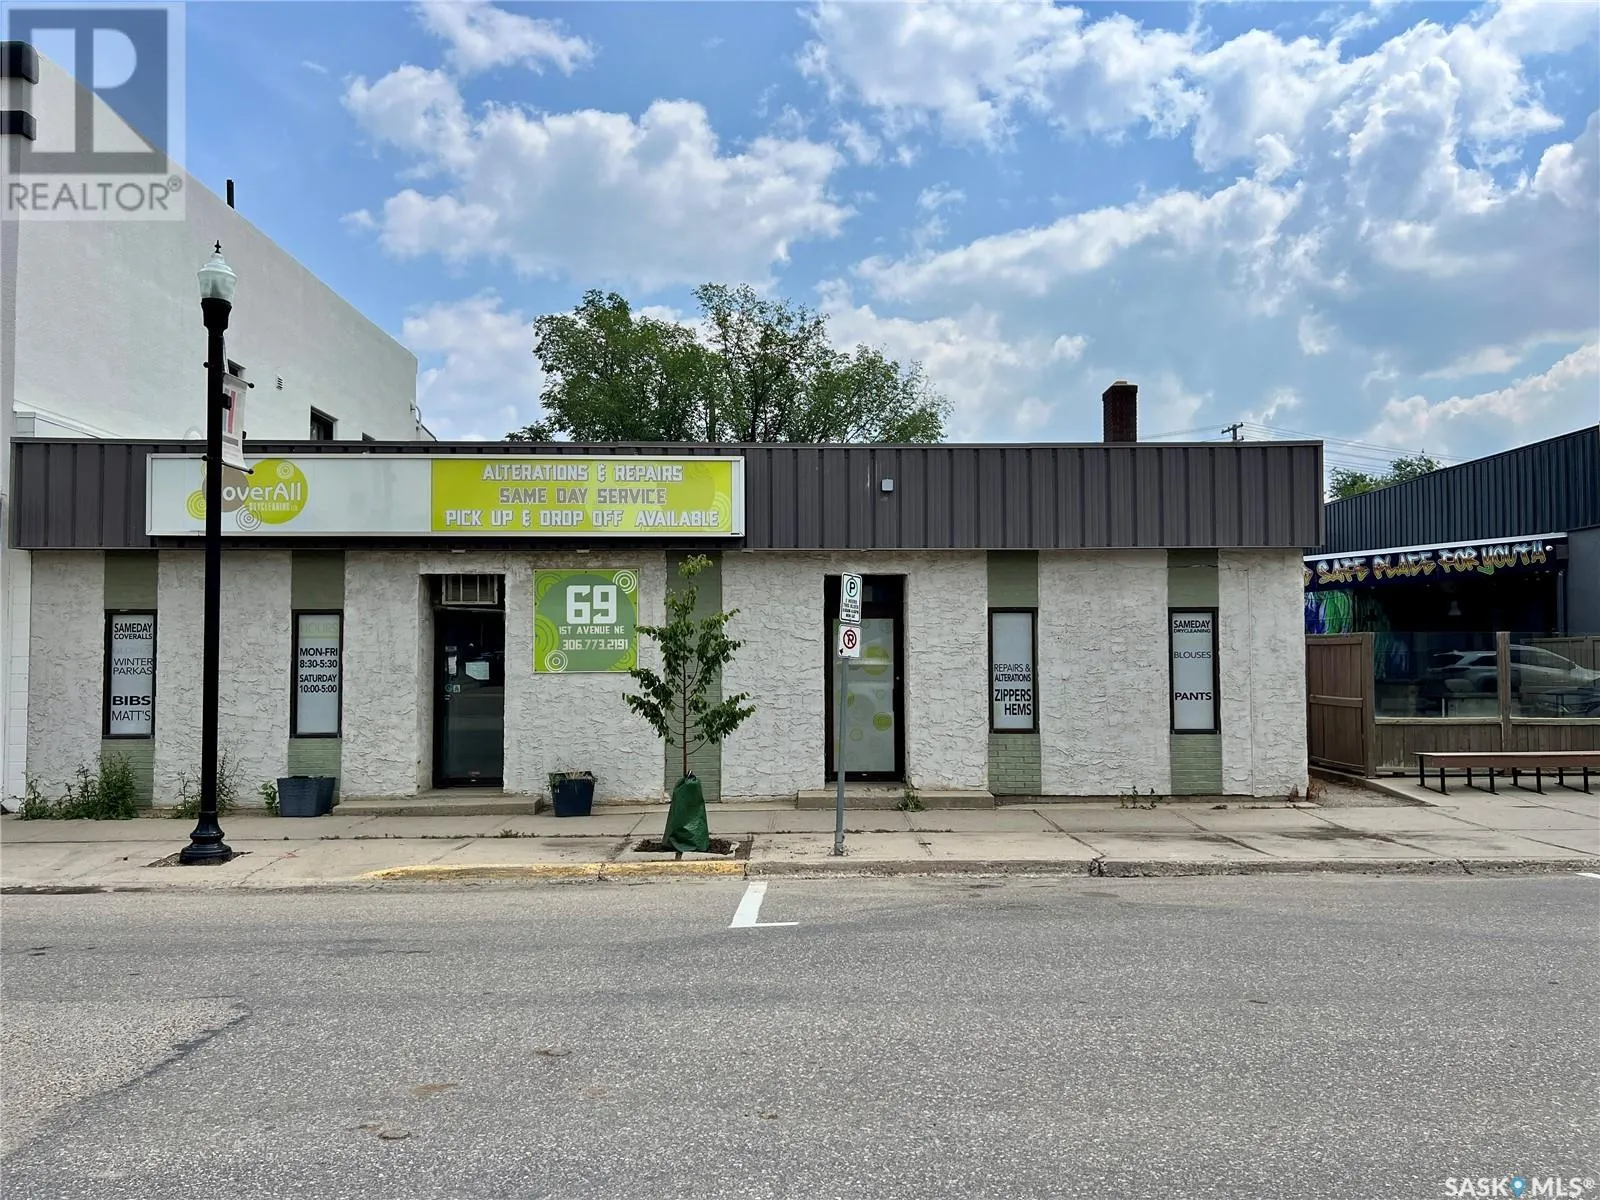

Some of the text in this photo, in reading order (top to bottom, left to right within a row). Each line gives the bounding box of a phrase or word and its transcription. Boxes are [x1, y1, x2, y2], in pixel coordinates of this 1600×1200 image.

[482, 463, 684, 483] ALTERATIONS & REPAIRS
[223, 482, 301, 501] overAll
[499, 487, 667, 505] SAME DAY SERVICE
[445, 509, 720, 528] PICK UP & DROP OFF AVAILABLE
[1438, 546, 1480, 573] FOR
[566, 585, 617, 624] 69
[114, 623, 153, 633] SAMEDAY
[1173, 620, 1211, 628] SAMEDAY
[577, 626, 610, 634] AVENUE
[614, 625, 625, 634] NE
[562, 639, 628, 650] 306.773.2191
[300, 648, 338, 656] MON-FRI
[1174, 651, 1211, 659] BLOUSES
[113, 658, 153, 666] WINTER
[299, 659, 337, 668] 8:30-5:30
[113, 667, 153, 675] PARKAS
[994, 664, 1031, 672] REPAIRS &
[299, 674, 337, 682] SATURDAY
[994, 674, 1031, 682] ALTERATIONS
[299, 685, 337, 693] 10:00-5:00
[994, 689, 1032, 701] ZIPPERS
[1174, 692, 1212, 700] PANTS
[112, 695, 151, 706] BIBS
[1004, 703, 1032, 716] HEMS
[111, 710, 151, 721] MATT'S
